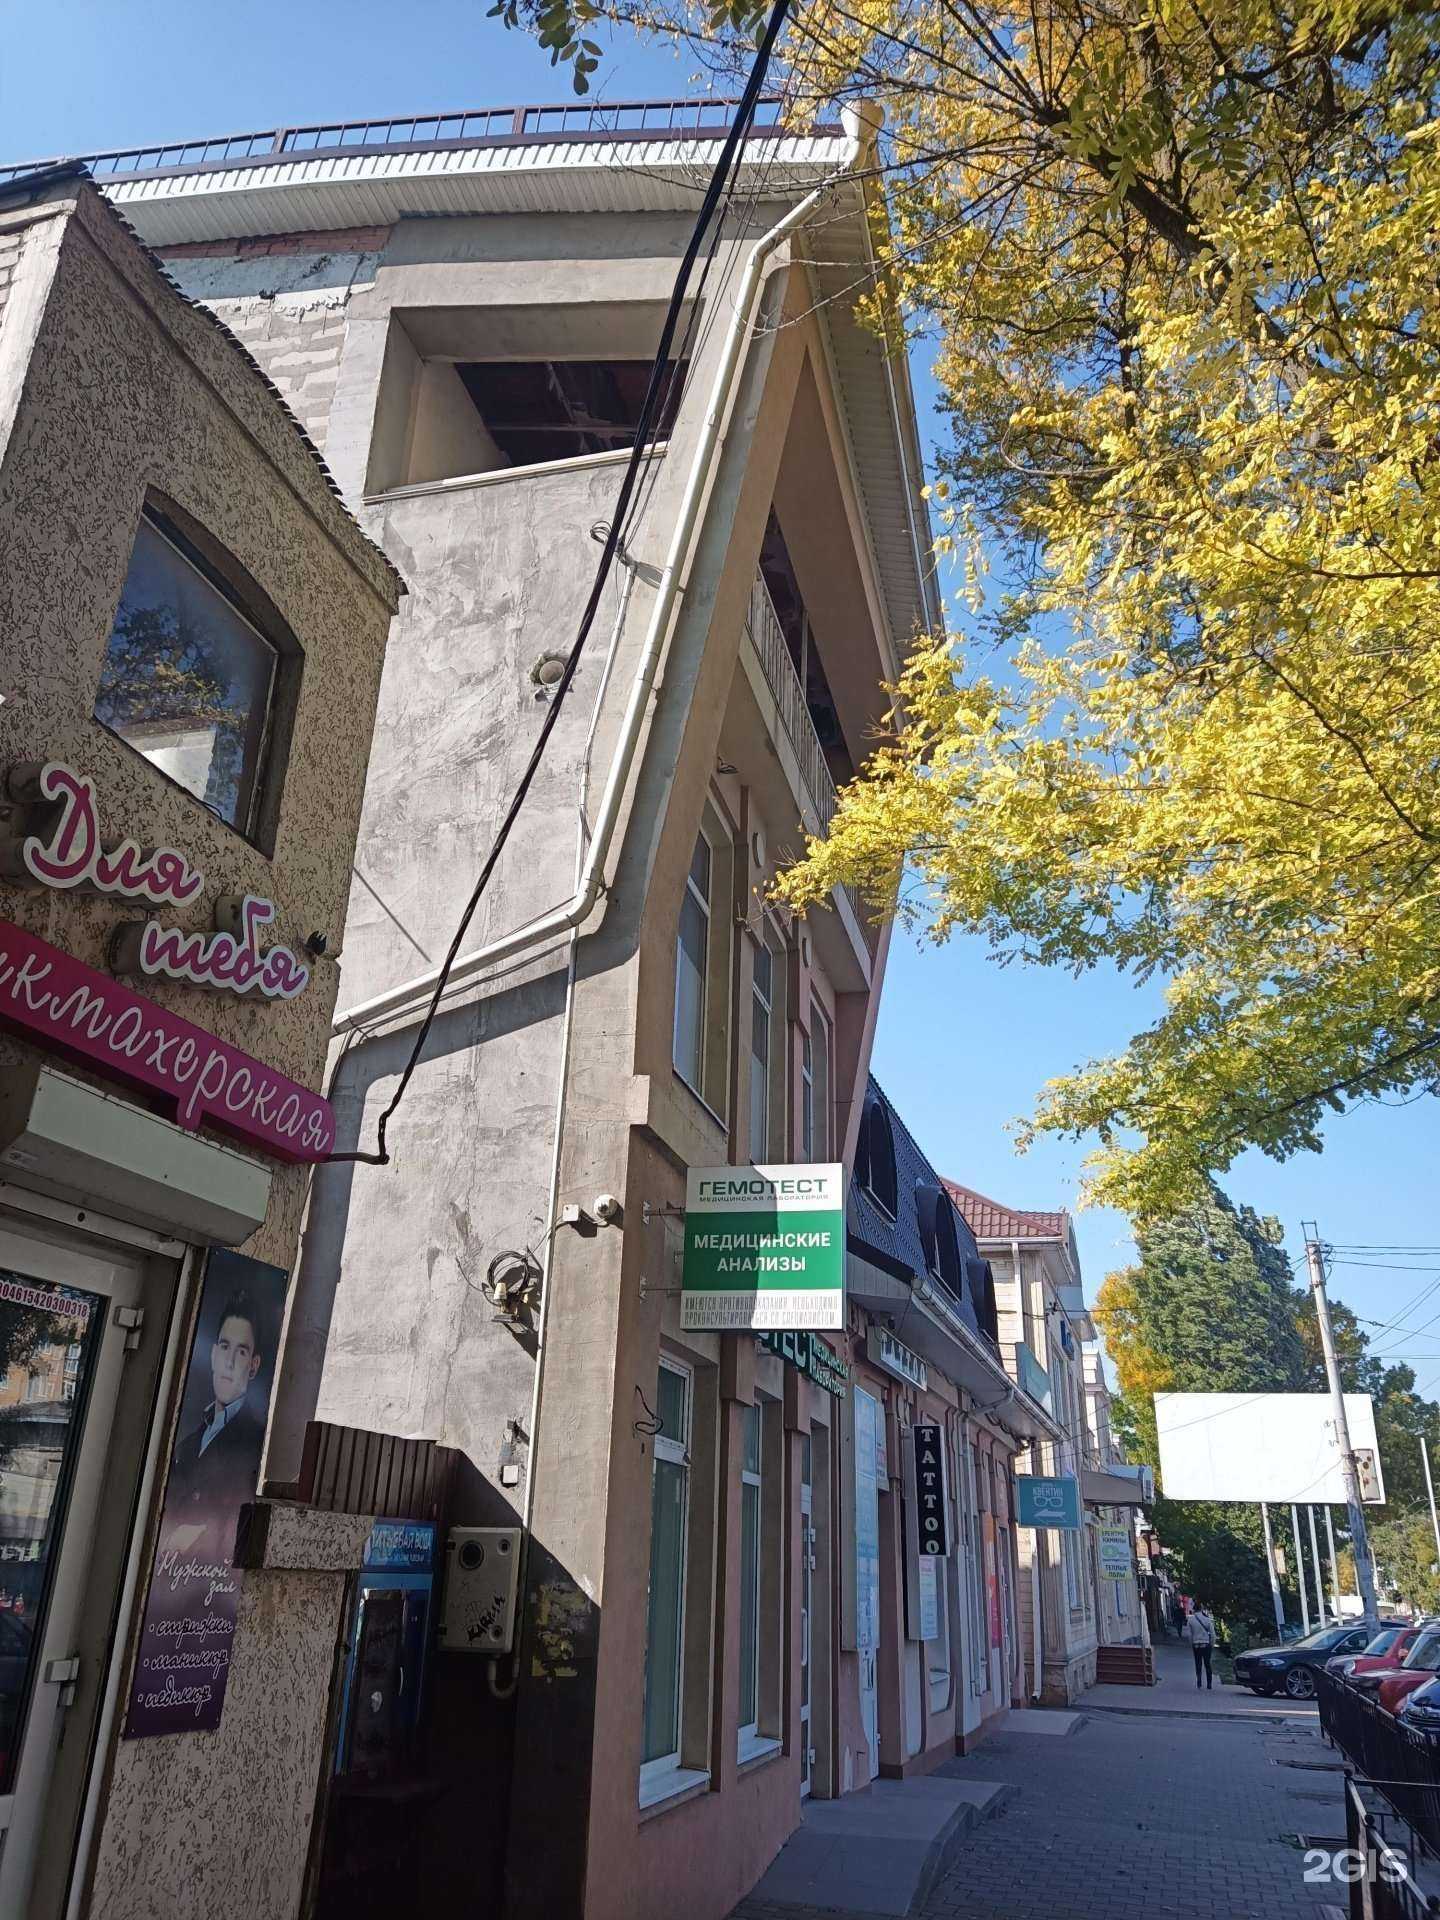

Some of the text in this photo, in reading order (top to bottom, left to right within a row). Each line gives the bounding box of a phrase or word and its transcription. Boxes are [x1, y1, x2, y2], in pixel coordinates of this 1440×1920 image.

[25, 764, 203, 905] Для
[141, 896, 308, 997] тебя
[699, 1179, 828, 1195] ГЕМОТЕСТ
[699, 1195, 764, 1203] МЕДИЦИНСКАЯ
[694, 1232, 831, 1250] МЕДИЦИНСКИЕ
[717, 1256, 806, 1272] АНАЛИЗЫ
[685, 1296, 716, 1311] ИМЕЮТСЯ
[921, 1428, 939, 1553] TATTOO
[157, 1551, 234, 1592] Мужской
[204, 1581, 236, 1606] зал
[156, 1611, 234, 1649] стрижки
[151, 1649, 228, 1680] маникюр
[145, 1674, 212, 1717] педикюр
